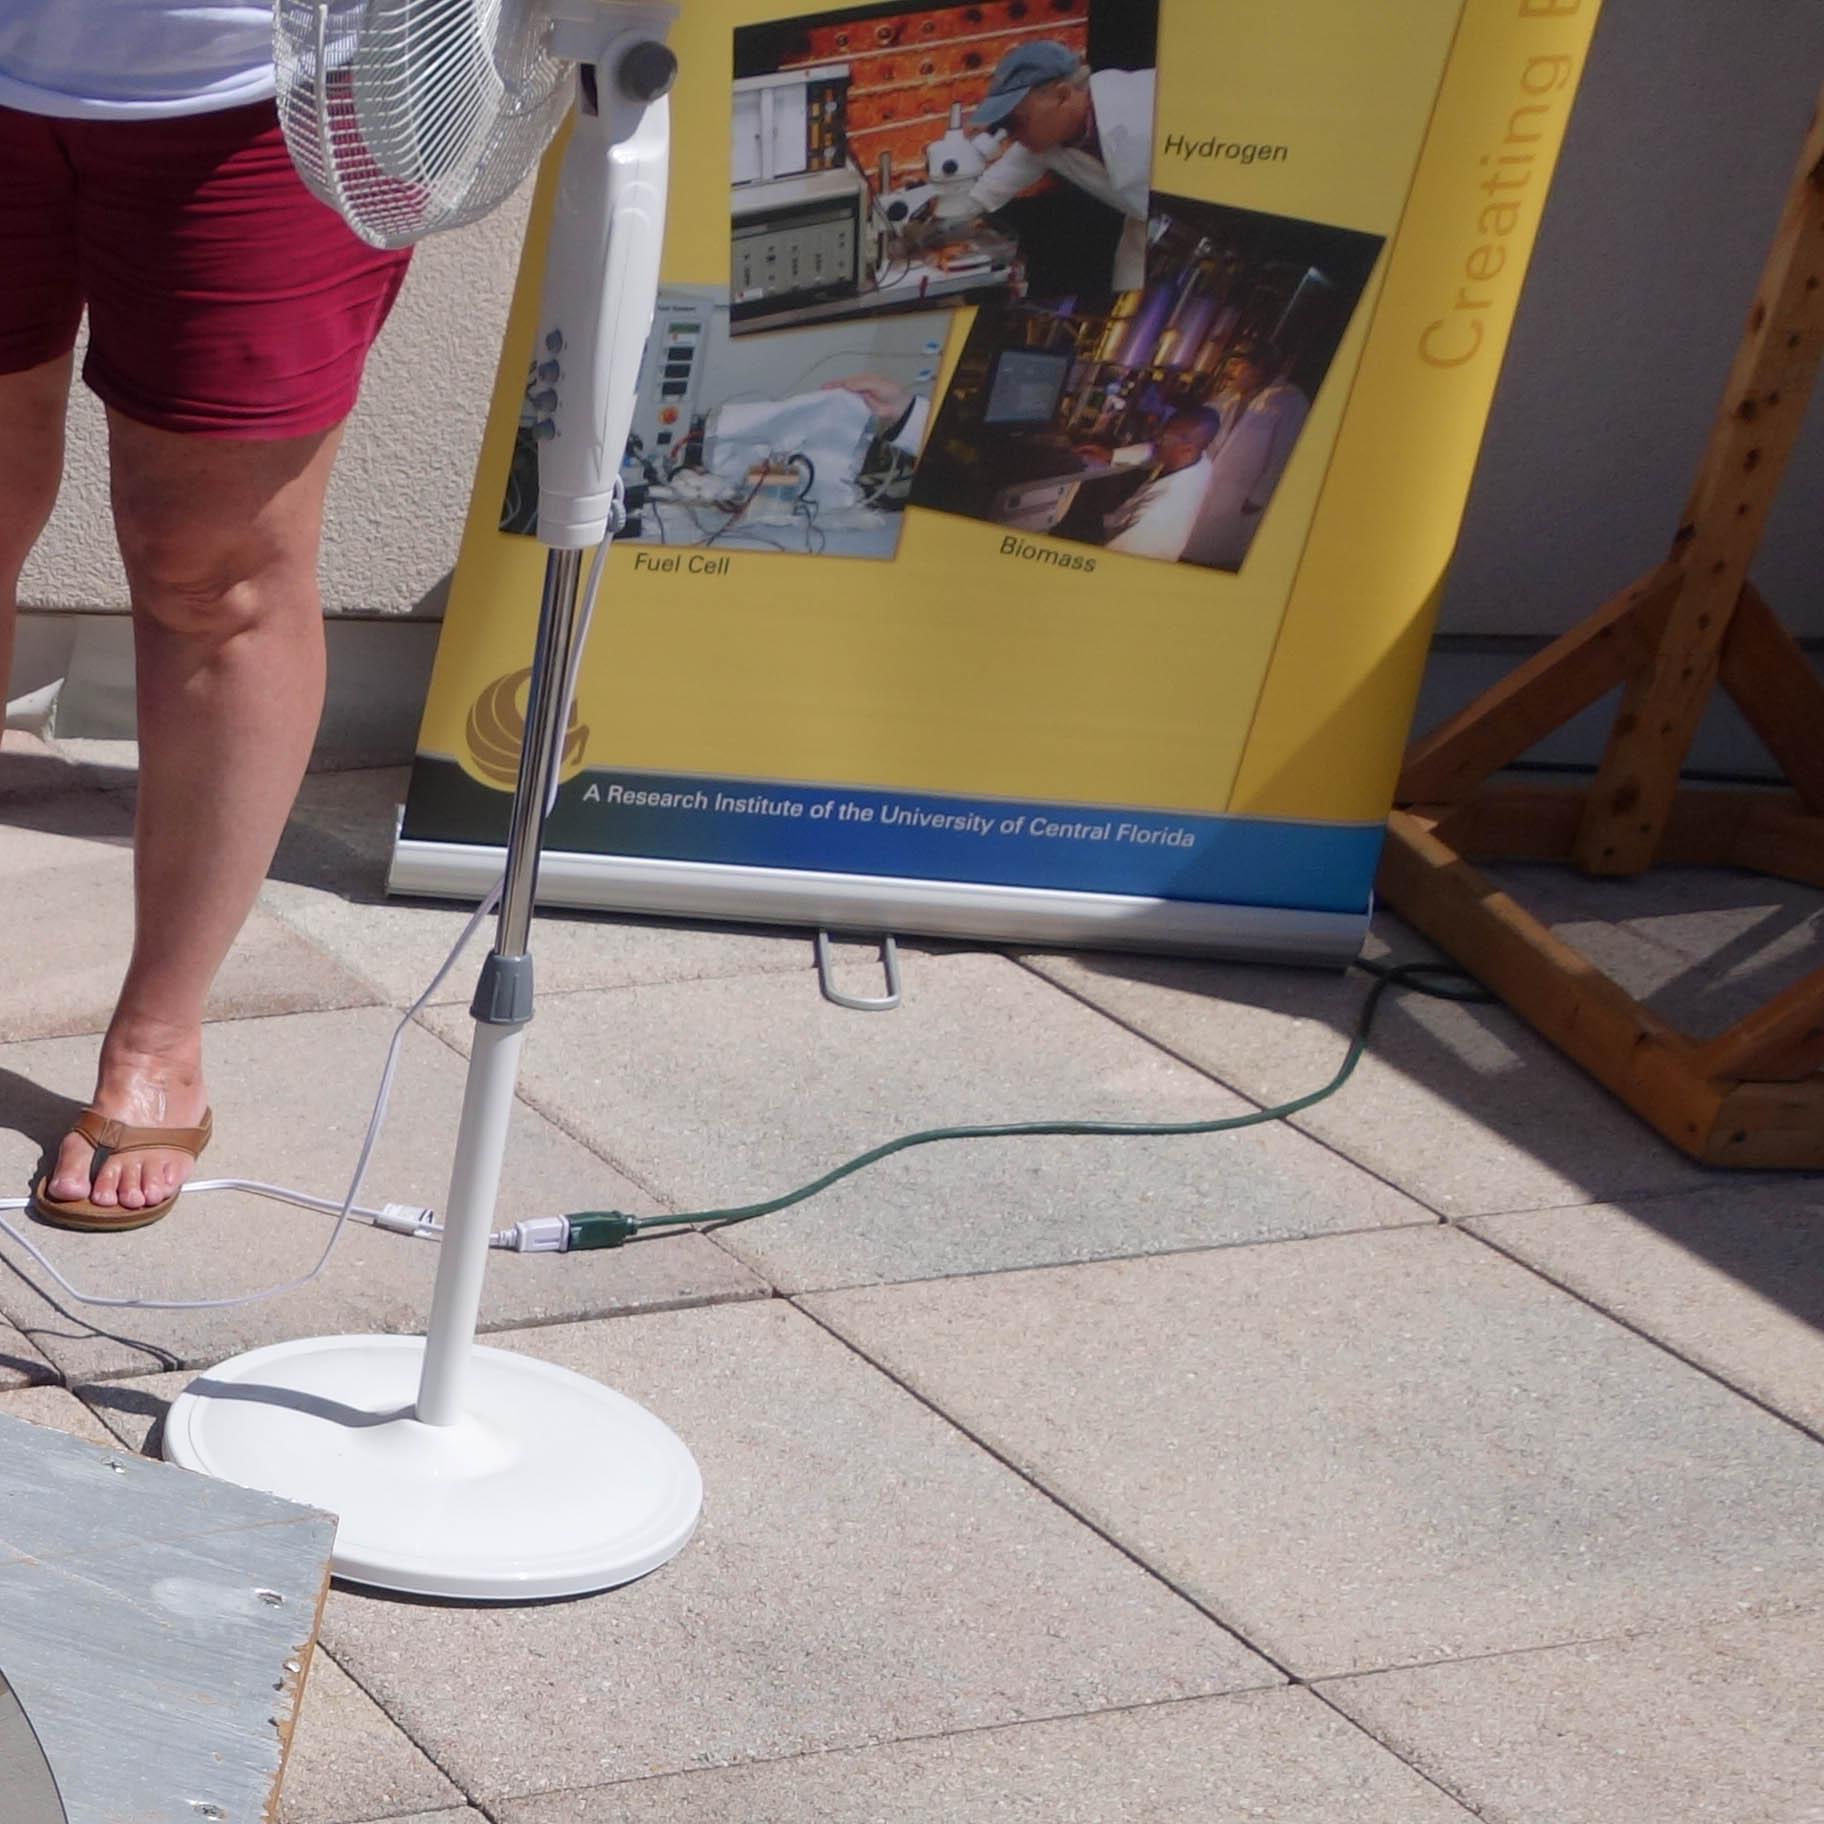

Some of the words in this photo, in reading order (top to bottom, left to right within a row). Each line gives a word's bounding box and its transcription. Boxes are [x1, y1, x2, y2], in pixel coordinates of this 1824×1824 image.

[1164, 134, 1288, 165] Hydrogen
[1417, 54, 1573, 370] Creating
[634, 552, 681, 573] Fuel
[688, 555, 730, 575] Cell
[1000, 536, 1096, 572] Biomass
[583, 784, 601, 802] A
[607, 785, 708, 809] Research
[715, 794, 803, 817] Institute
[809, 800, 835, 820] of
[838, 802, 874, 822] the
[880, 805, 995, 836] University
[1000, 816, 1026, 835] of
[1030, 818, 1110, 841] Central
[1116, 823, 1196, 848] Florida
